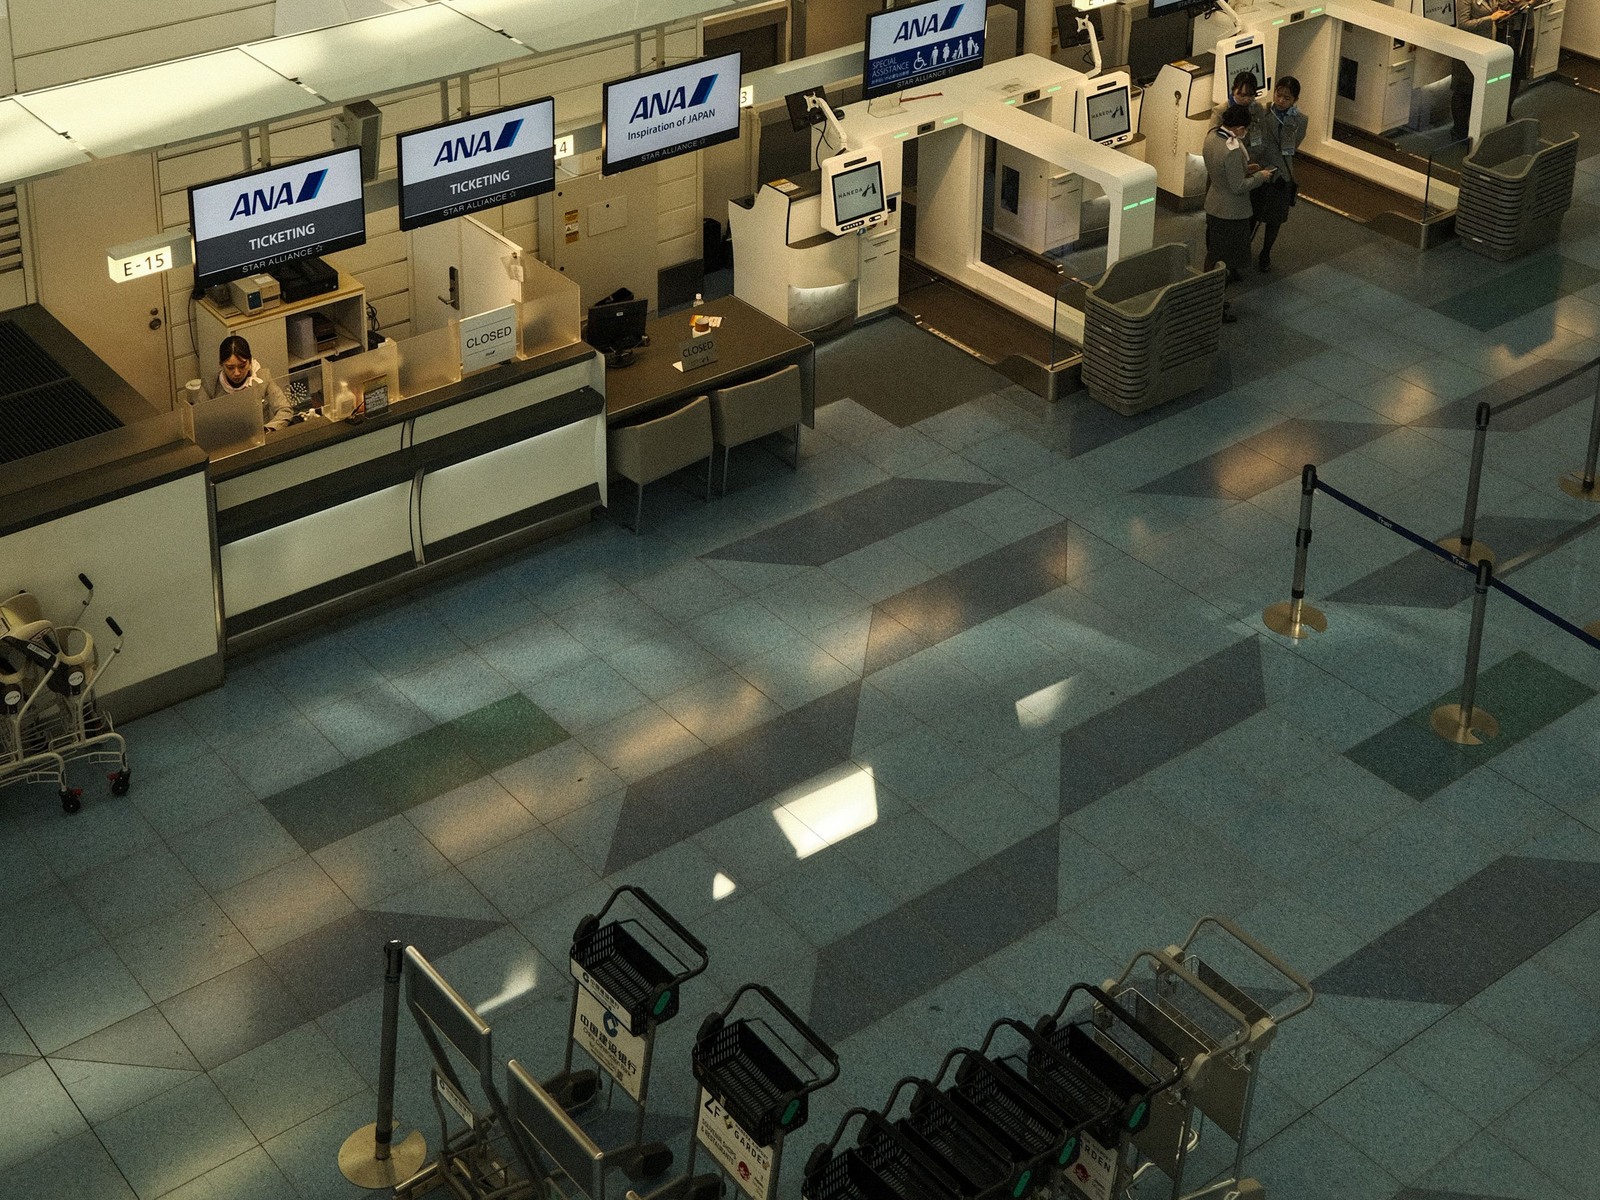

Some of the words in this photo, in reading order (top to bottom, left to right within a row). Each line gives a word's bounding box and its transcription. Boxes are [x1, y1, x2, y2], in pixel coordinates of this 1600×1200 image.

[893, 13, 938, 44] ANA
[871, 61, 910, 78] ASSISTANCE
[872, 56, 897, 69] SPECIAL
[897, 78, 914, 88] STAR
[915, 70, 946, 82] ALLIANCE
[628, 86, 686, 124] ANA
[627, 122, 675, 141] Inspiration
[676, 115, 686, 127] of
[687, 109, 716, 124] JAPAN
[433, 130, 492, 167] ANA
[641, 151, 661, 162] STAR
[661, 141, 698, 156] ALLIANCE
[450, 170, 510, 195] TICKETING
[838, 187, 863, 199] HANEDA
[229, 182, 294, 221] ANA
[443, 205, 465, 217] STAR
[466, 194, 507, 210] ALLIANCE
[248, 223, 316, 251] TICKETING
[123, 253, 165, 277] E-15
[242, 260, 266, 273] STAR
[268, 248, 313, 266] ALLIANCE
[466, 326, 512, 348] CLOSED
[682, 340, 714, 358] CLOSED
